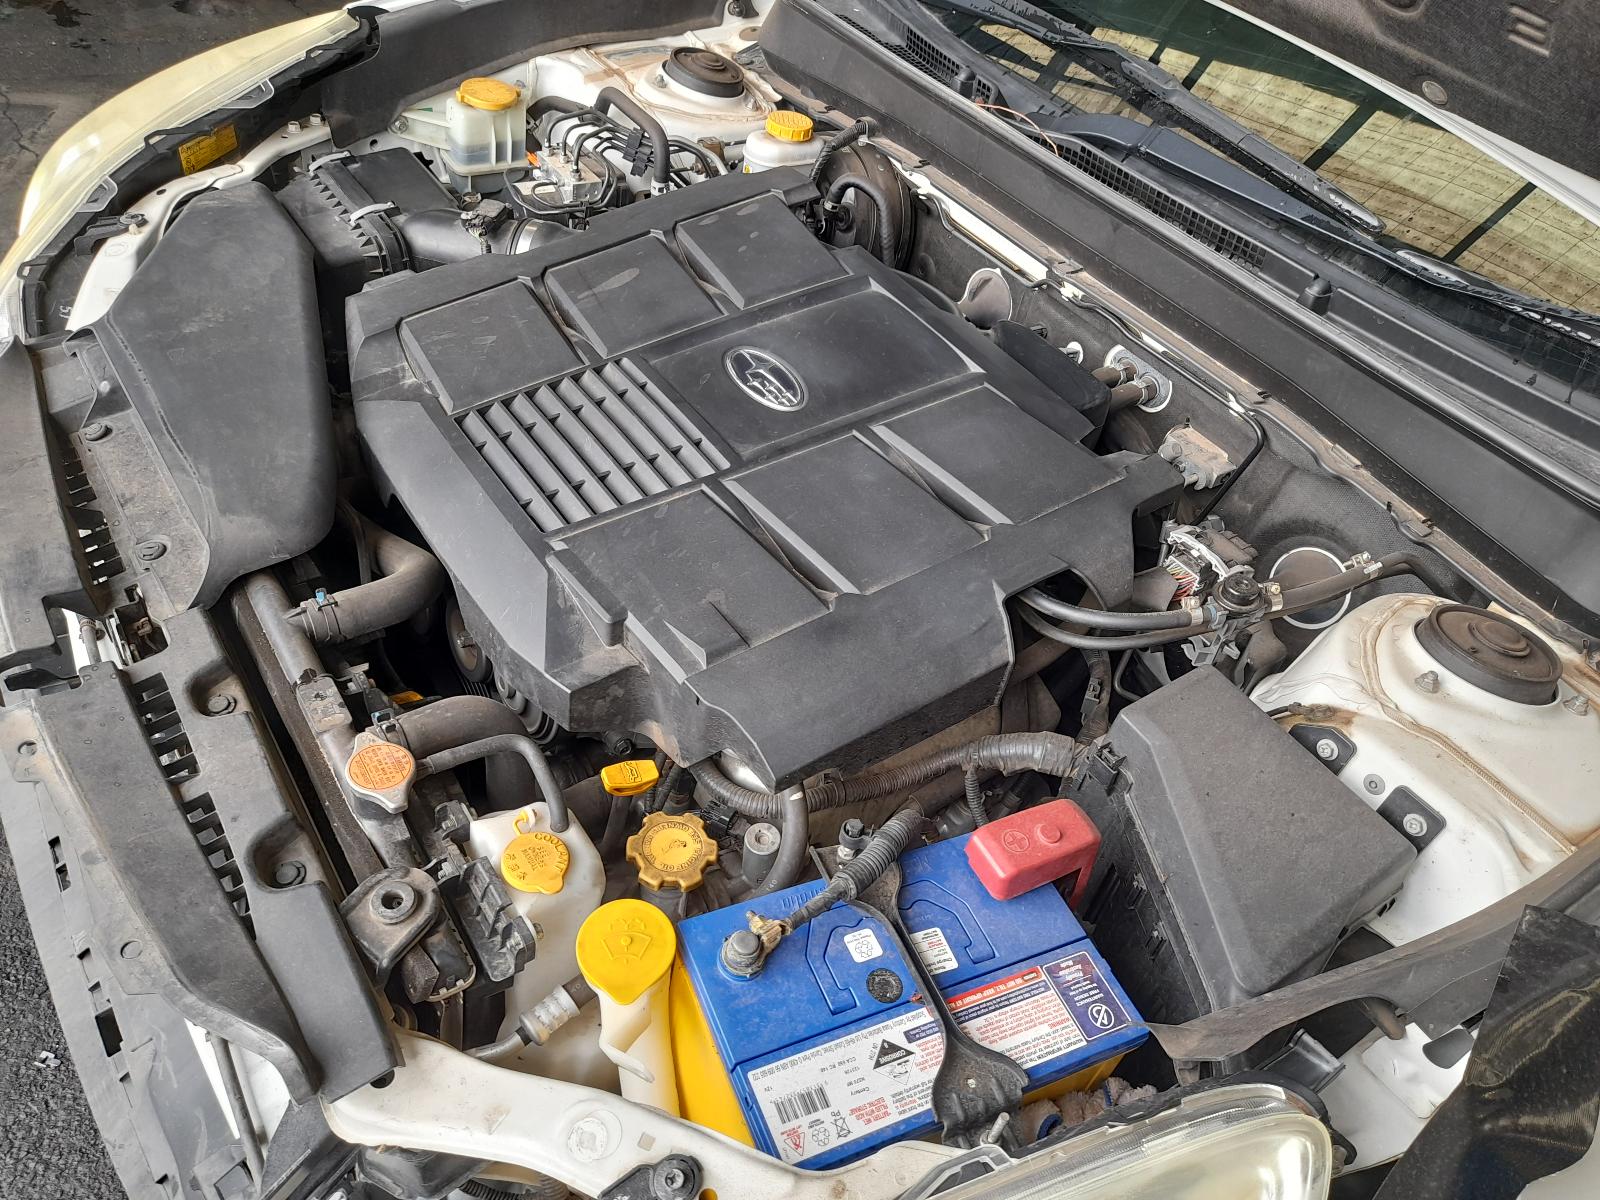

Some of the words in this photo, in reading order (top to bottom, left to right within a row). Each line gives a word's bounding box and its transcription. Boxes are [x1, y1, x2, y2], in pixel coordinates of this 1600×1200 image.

[878, 1049, 907, 1064] CORROSIVE
[849, 1085, 870, 1097] Century
[866, 1097, 885, 1108] ELECTRIC
[874, 1104, 888, 1112] FILLED
[830, 1110, 841, 1118] Pb
